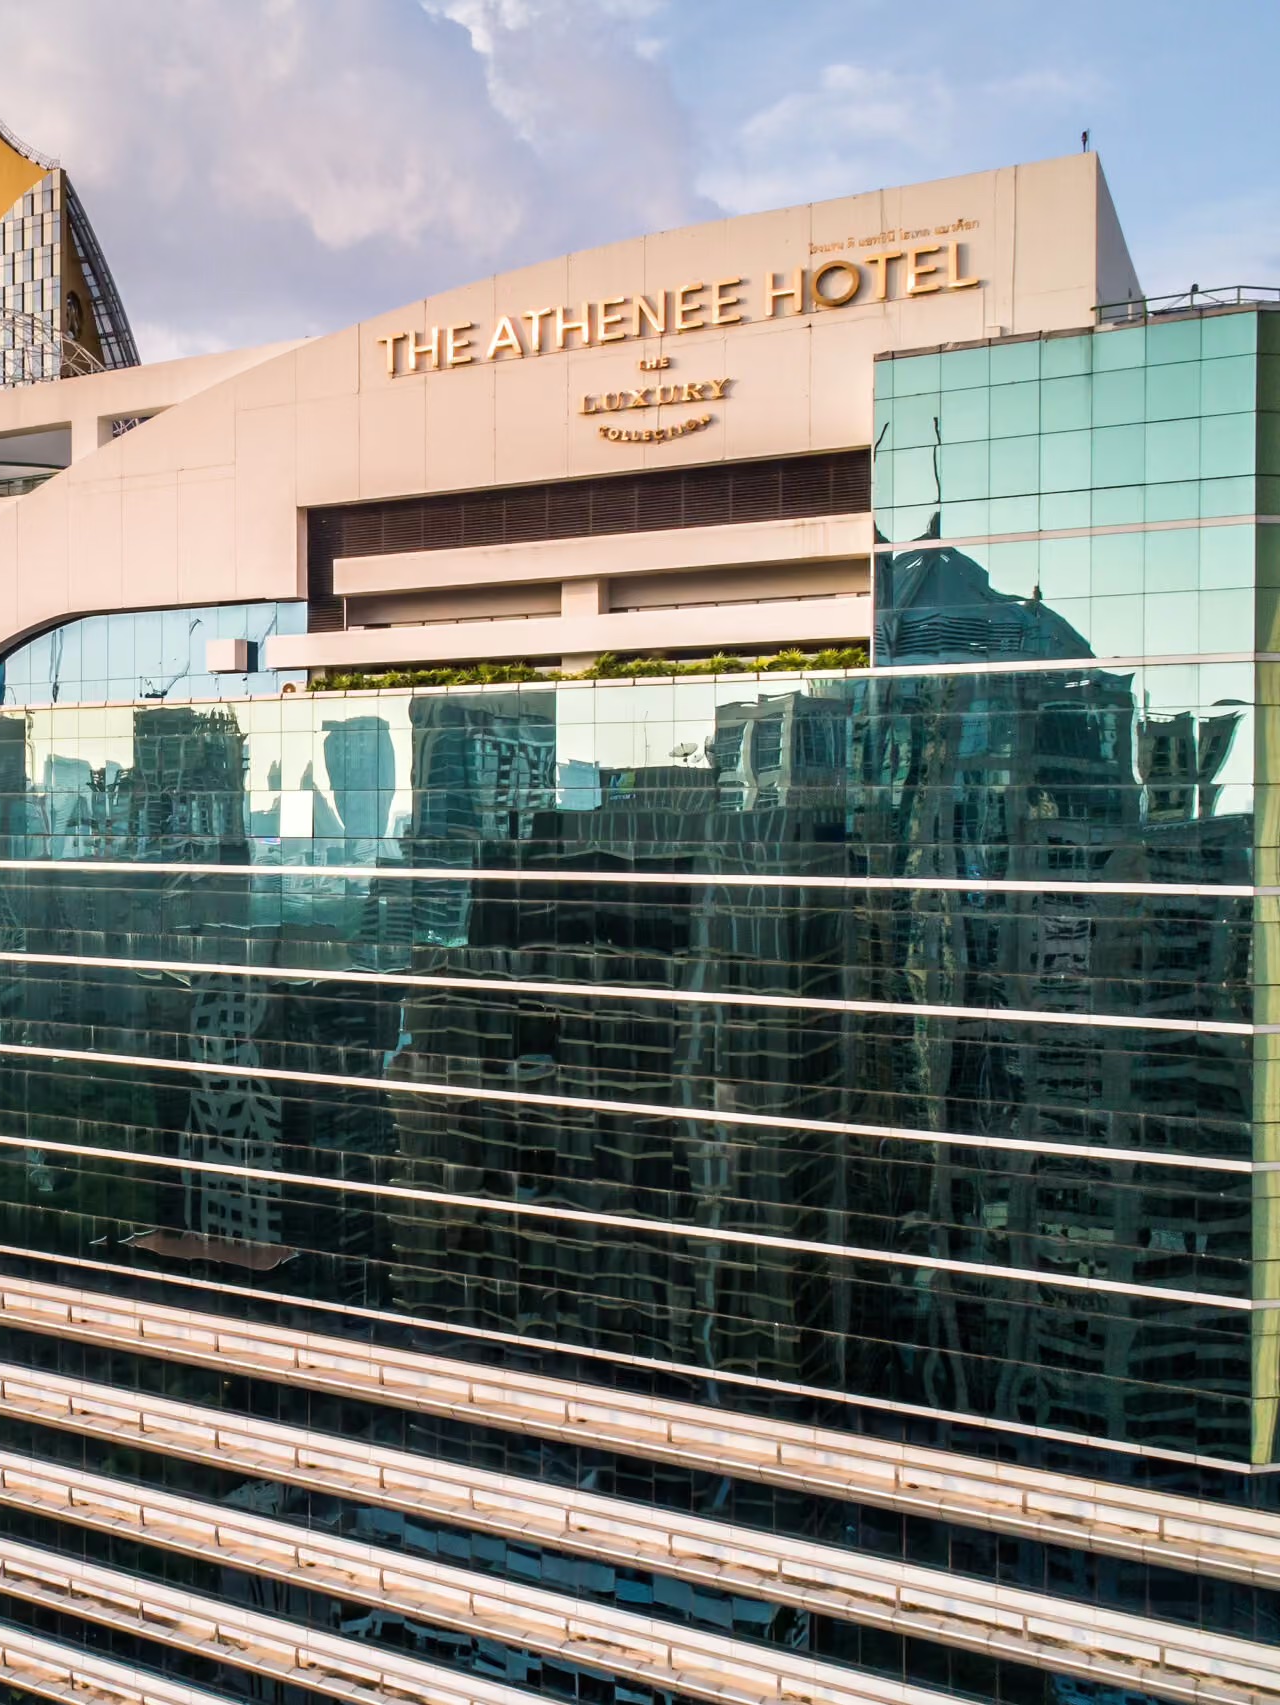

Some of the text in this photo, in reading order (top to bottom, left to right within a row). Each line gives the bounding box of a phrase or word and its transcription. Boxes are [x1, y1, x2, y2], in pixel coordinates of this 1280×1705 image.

[376, 239, 980, 376] THE ATHENEE HOTEL
[638, 356, 671, 371] THE
[578, 377, 731, 415] LUXURY
[598, 412, 713, 444] COLLECTION
